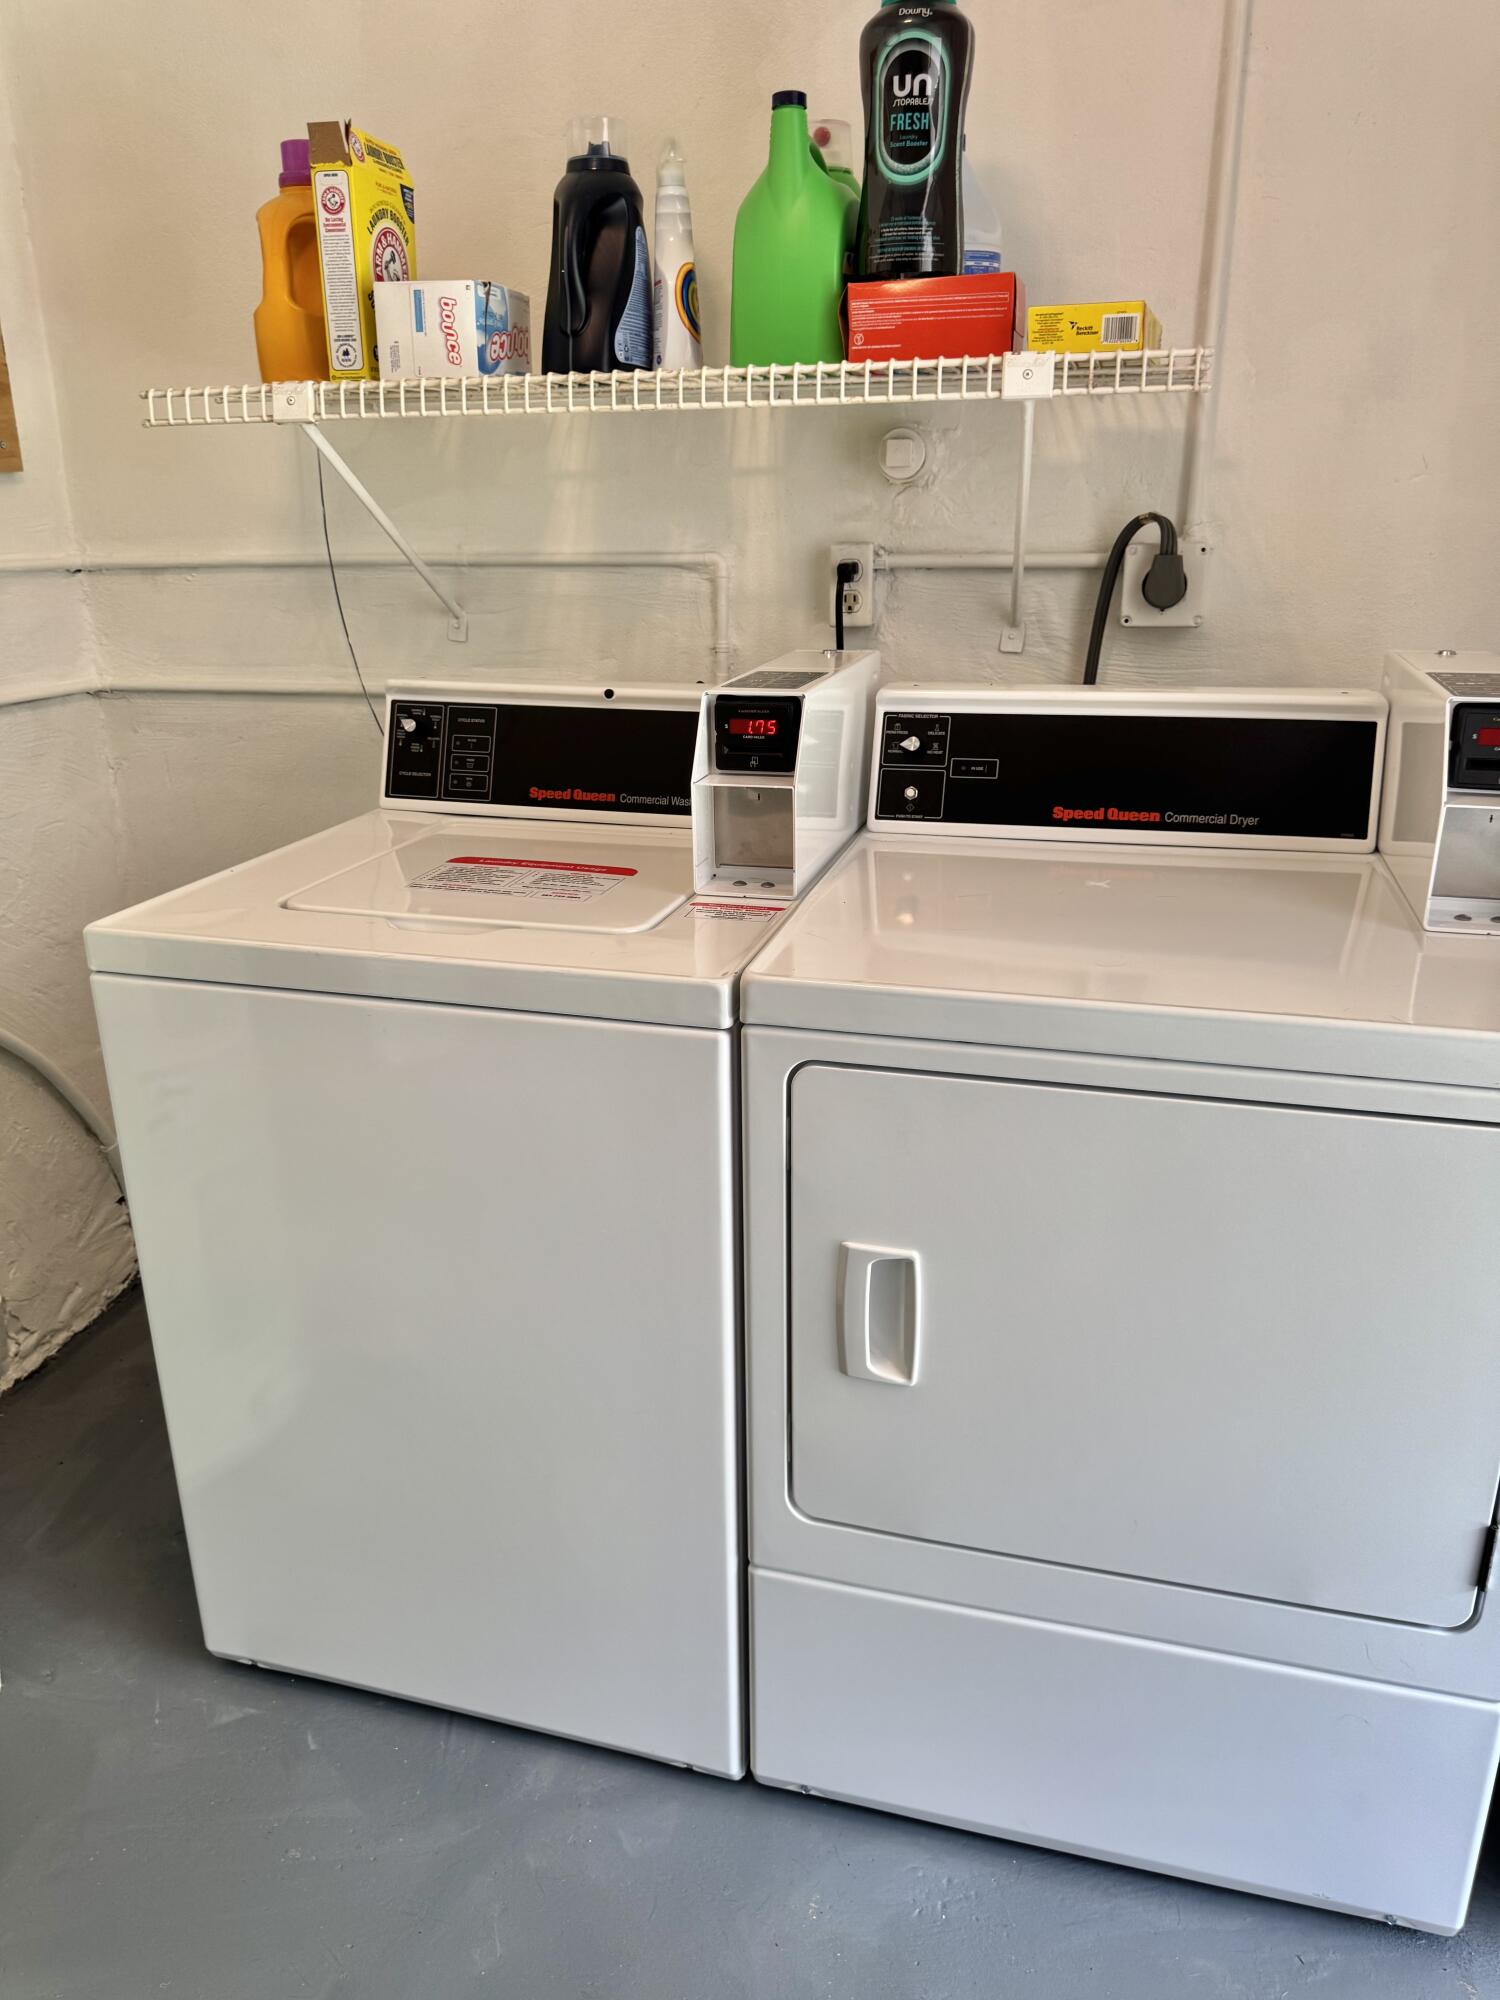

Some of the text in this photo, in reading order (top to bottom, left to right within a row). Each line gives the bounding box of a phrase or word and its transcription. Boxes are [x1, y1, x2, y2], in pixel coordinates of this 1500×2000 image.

[899, 8, 930, 17] Downy
[890, 112, 929, 131] FRESH
[890, 140, 905, 148] Scent
[374, 242, 385, 277] ARM
[440, 297, 462, 366] bounce
[529, 786, 691, 807] Speed Queen Commercial Was
[1052, 806, 1260, 827] Speed Queen Commercial Dryer
